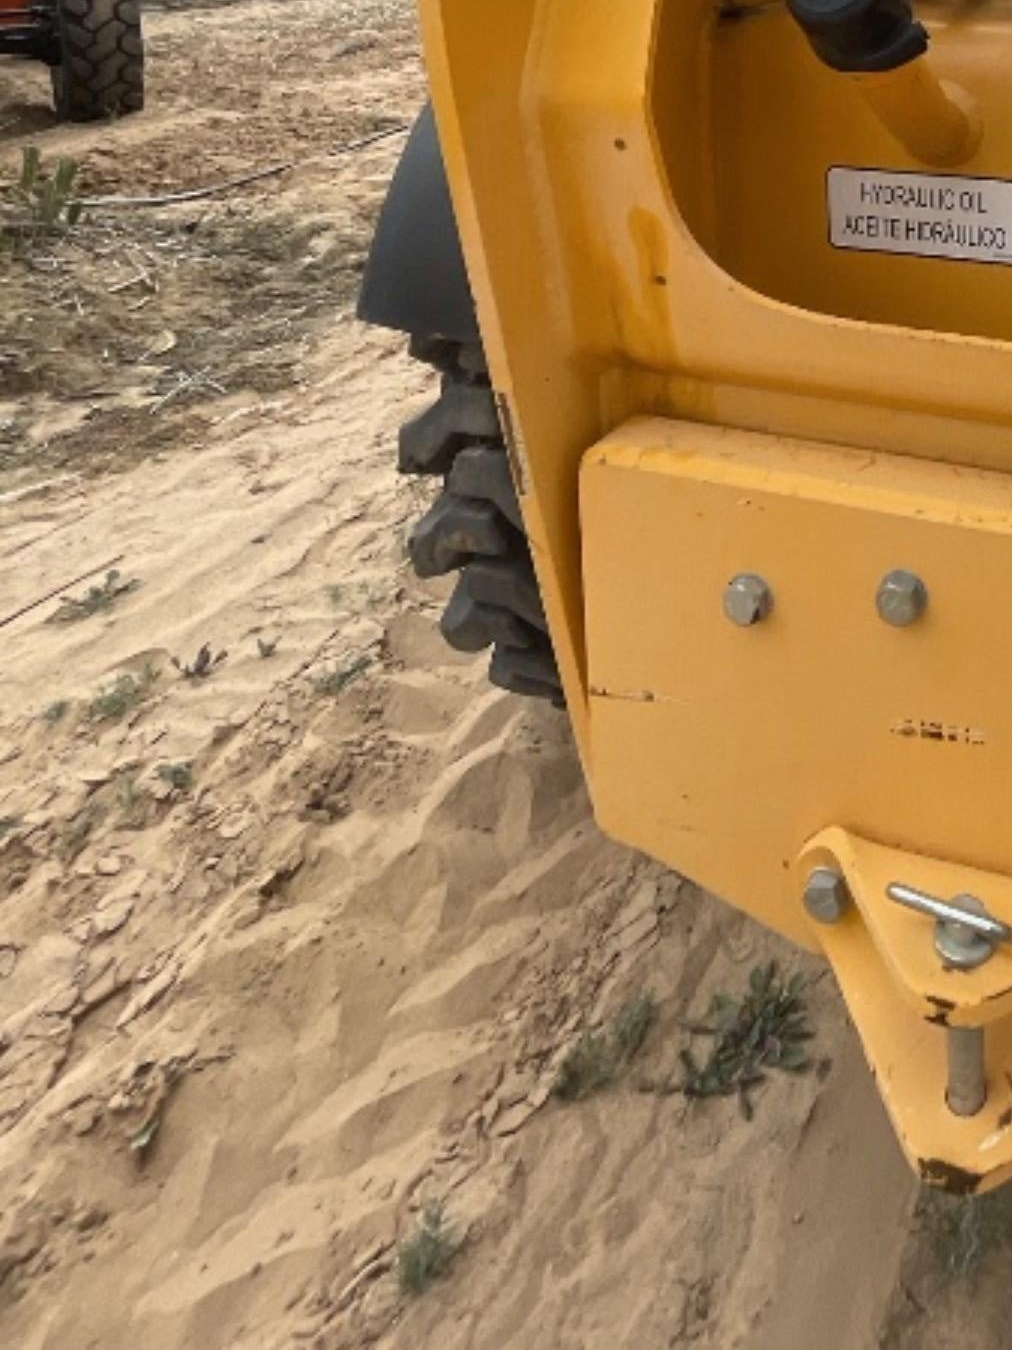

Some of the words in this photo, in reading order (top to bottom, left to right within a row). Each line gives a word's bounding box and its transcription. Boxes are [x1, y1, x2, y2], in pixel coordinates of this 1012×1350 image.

[859, 182, 955, 211] HYDRAULIC
[959, 191, 988, 213] OIL
[843, 215, 901, 241] ACEITE
